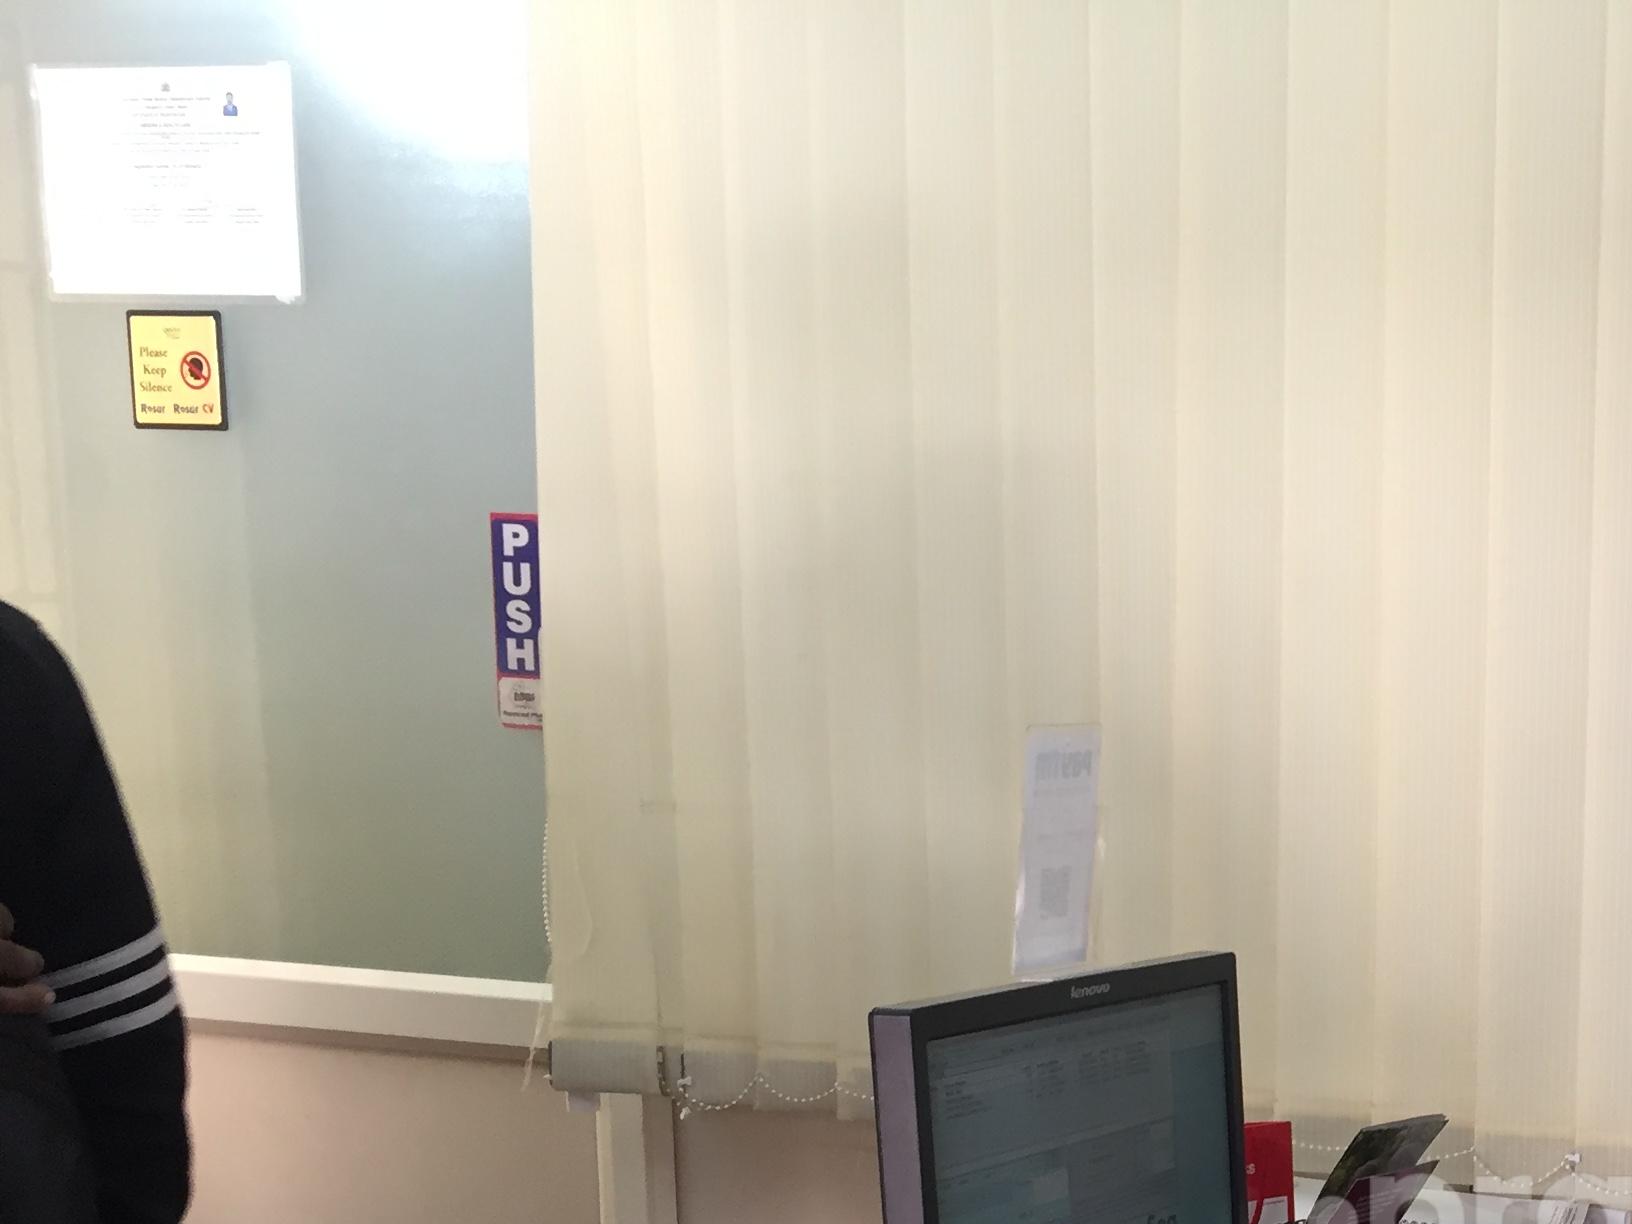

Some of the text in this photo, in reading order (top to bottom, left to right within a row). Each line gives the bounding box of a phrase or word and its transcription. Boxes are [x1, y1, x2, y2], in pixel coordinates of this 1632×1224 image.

[140, 346, 168, 358] Please
[143, 364, 167, 378] Keep
[139, 381, 172, 392] Silence
[502, 523, 535, 671] PUSH
[1071, 983, 1110, 999] lenovo
